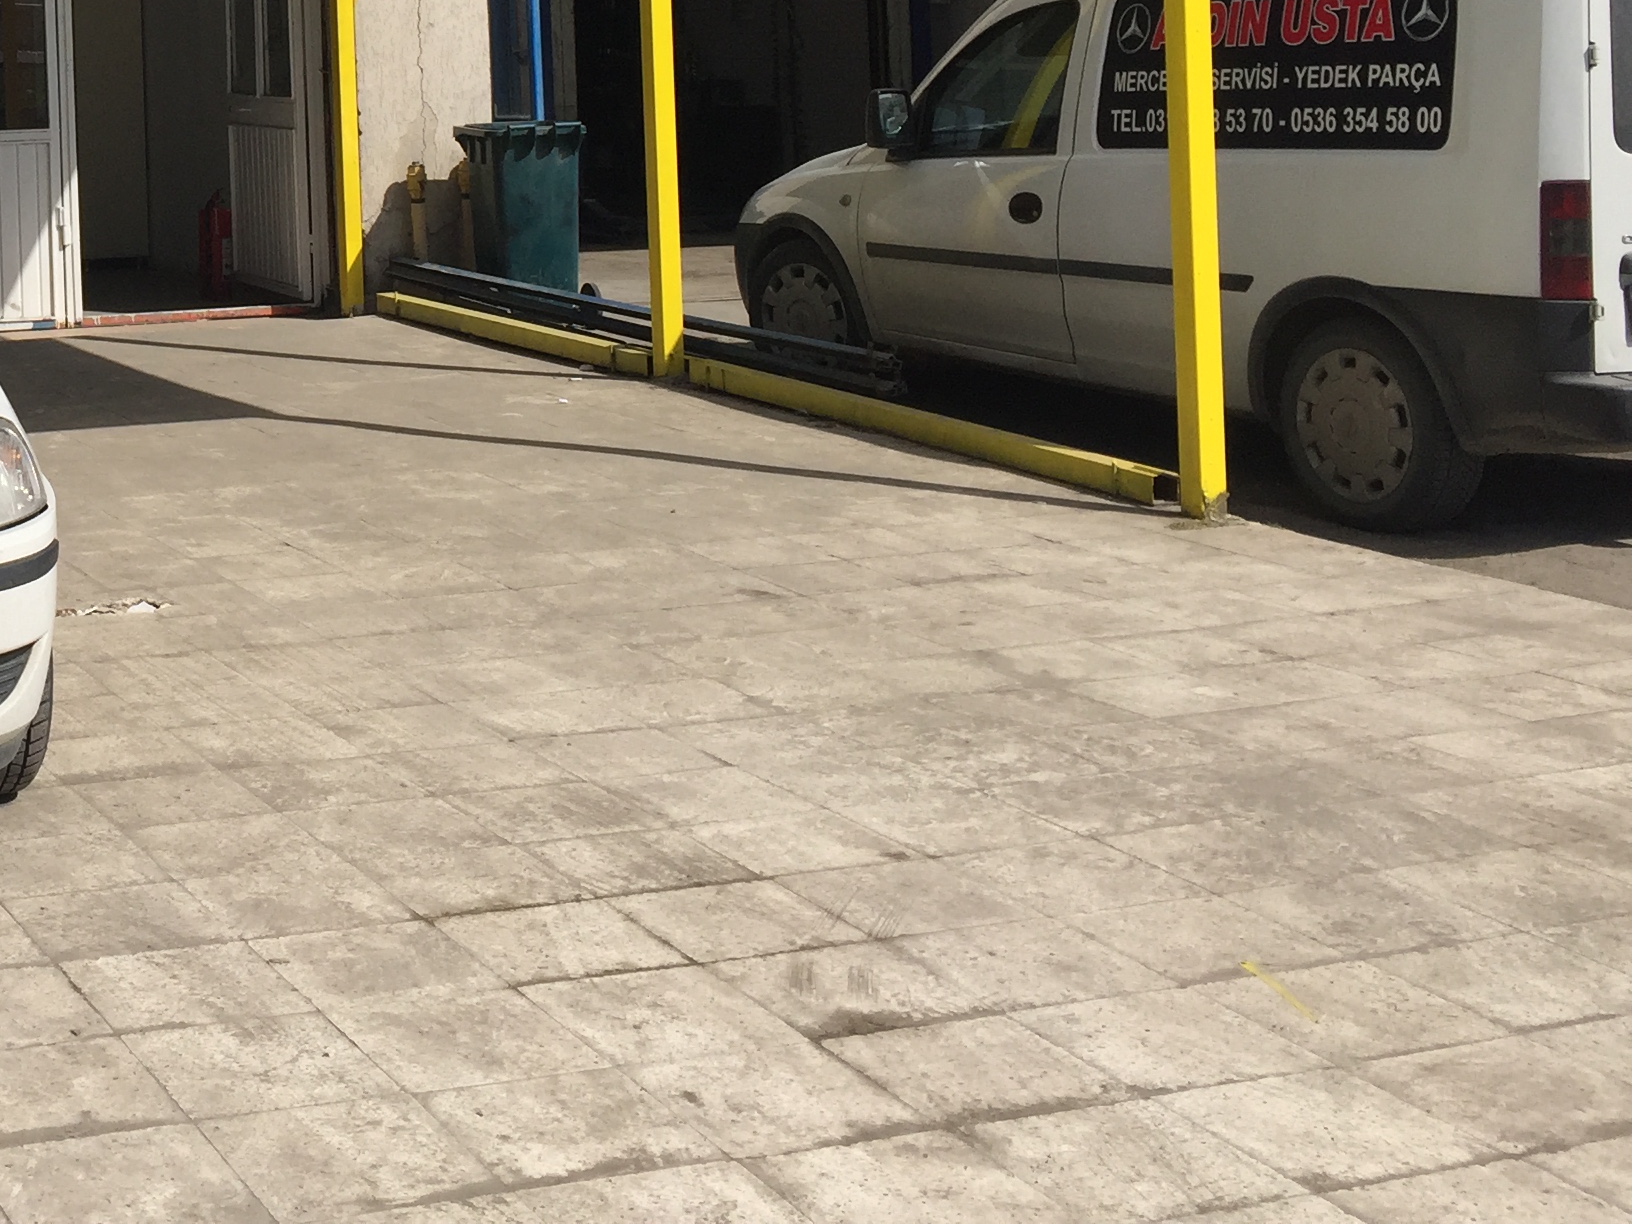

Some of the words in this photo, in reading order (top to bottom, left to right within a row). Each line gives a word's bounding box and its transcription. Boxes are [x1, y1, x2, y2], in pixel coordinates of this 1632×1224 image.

[1114, 70, 1168, 93] MERCE
[1294, 64, 1363, 89] YEDEK
[1368, 62, 1442, 94] PARÇA
[1111, 109, 1169, 133] TEL.03
[1225, 108, 1246, 133] 53
[1252, 107, 1274, 133] 70
[1291, 107, 1337, 133] 0536
[1343, 106, 1379, 133] 354
[1385, 106, 1410, 133] 58
[1417, 106, 1442, 133] 00
